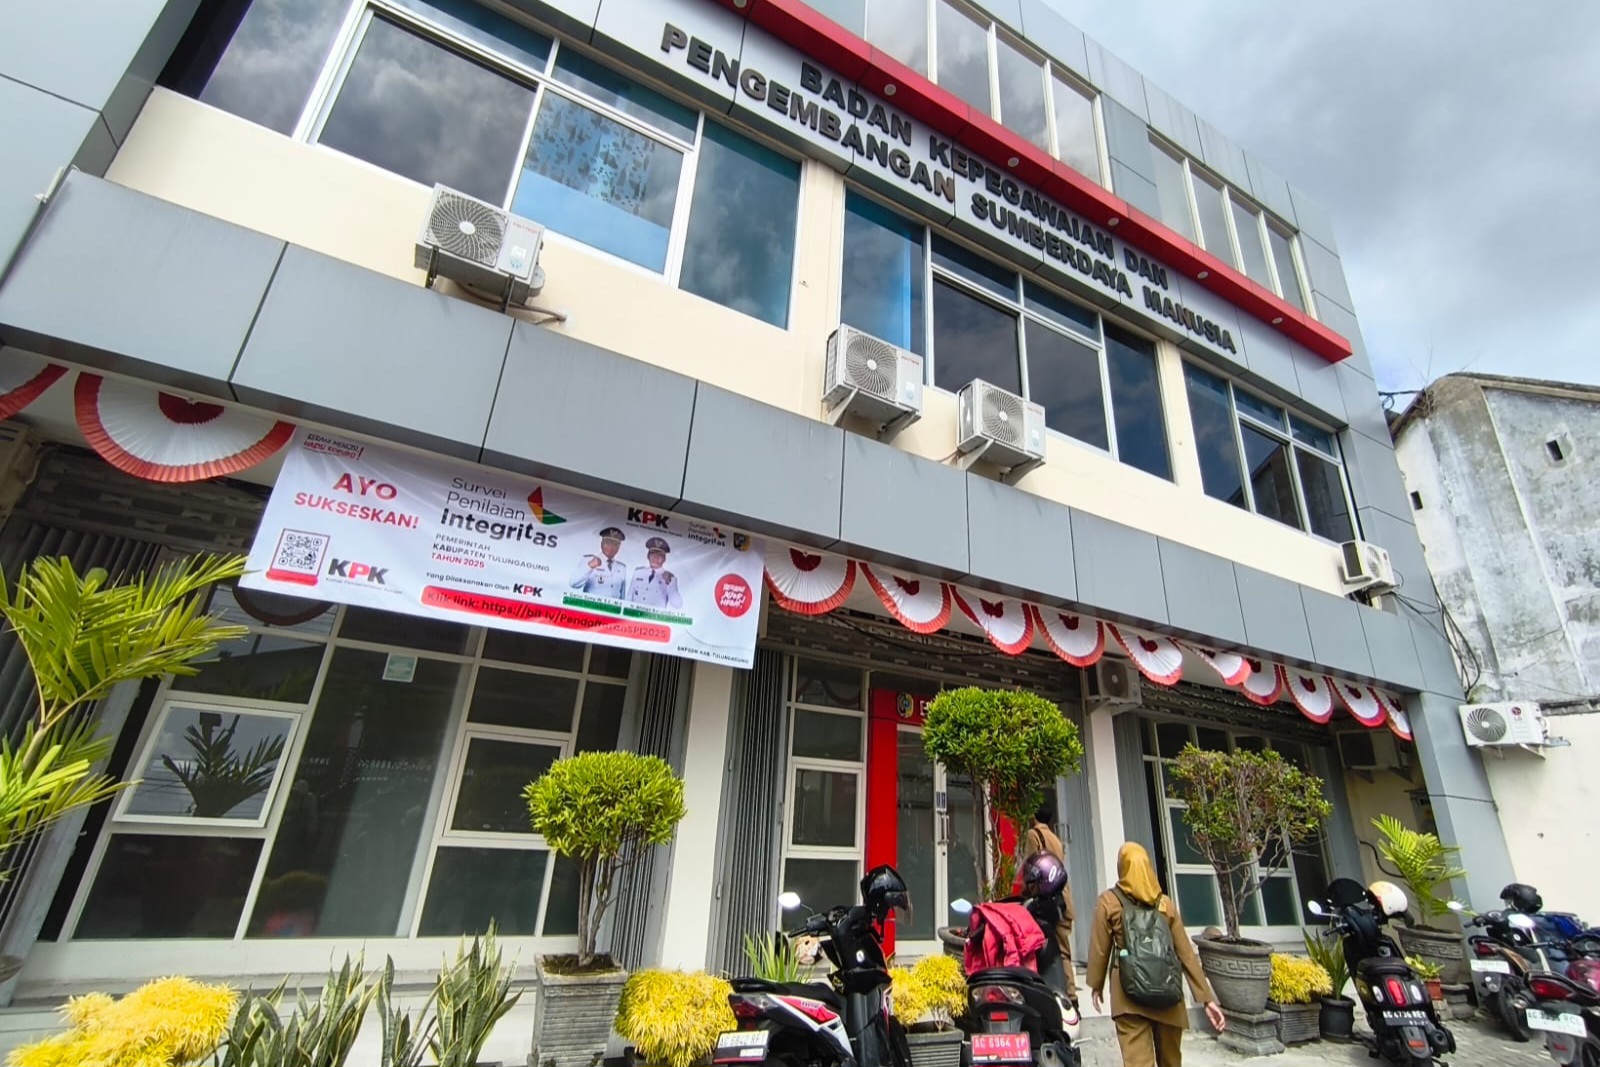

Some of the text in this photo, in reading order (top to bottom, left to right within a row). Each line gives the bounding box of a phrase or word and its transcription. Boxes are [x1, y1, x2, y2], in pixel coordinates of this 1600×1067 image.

[660, 22, 1237, 354] PENGEMBANGAN SUMBERDAYA MANUSIA
[800, 61, 1169, 290] BADAN KEPEGAWAIAN DAN
[333, 472, 397, 500] AYO
[451, 477, 507, 499] Survei
[294, 492, 419, 529] SUKSESKAN!
[446, 491, 525, 521] Penilaian
[627, 507, 670, 529] KPK
[440, 508, 558, 548] Integritas
[688, 532, 726, 547] Integritas
[435, 533, 490, 551] PEMERINTAH
[431, 552, 485, 568] TAHUN 2025
[433, 543, 550, 572] KABUPATEN TULUNGAGUNG
[328, 558, 389, 585] KPK
[426, 572, 543, 597] Yang Dilaksanakan Oleh KPK
[427, 592, 450, 603] Klik
[453, 595, 479, 608] link:
